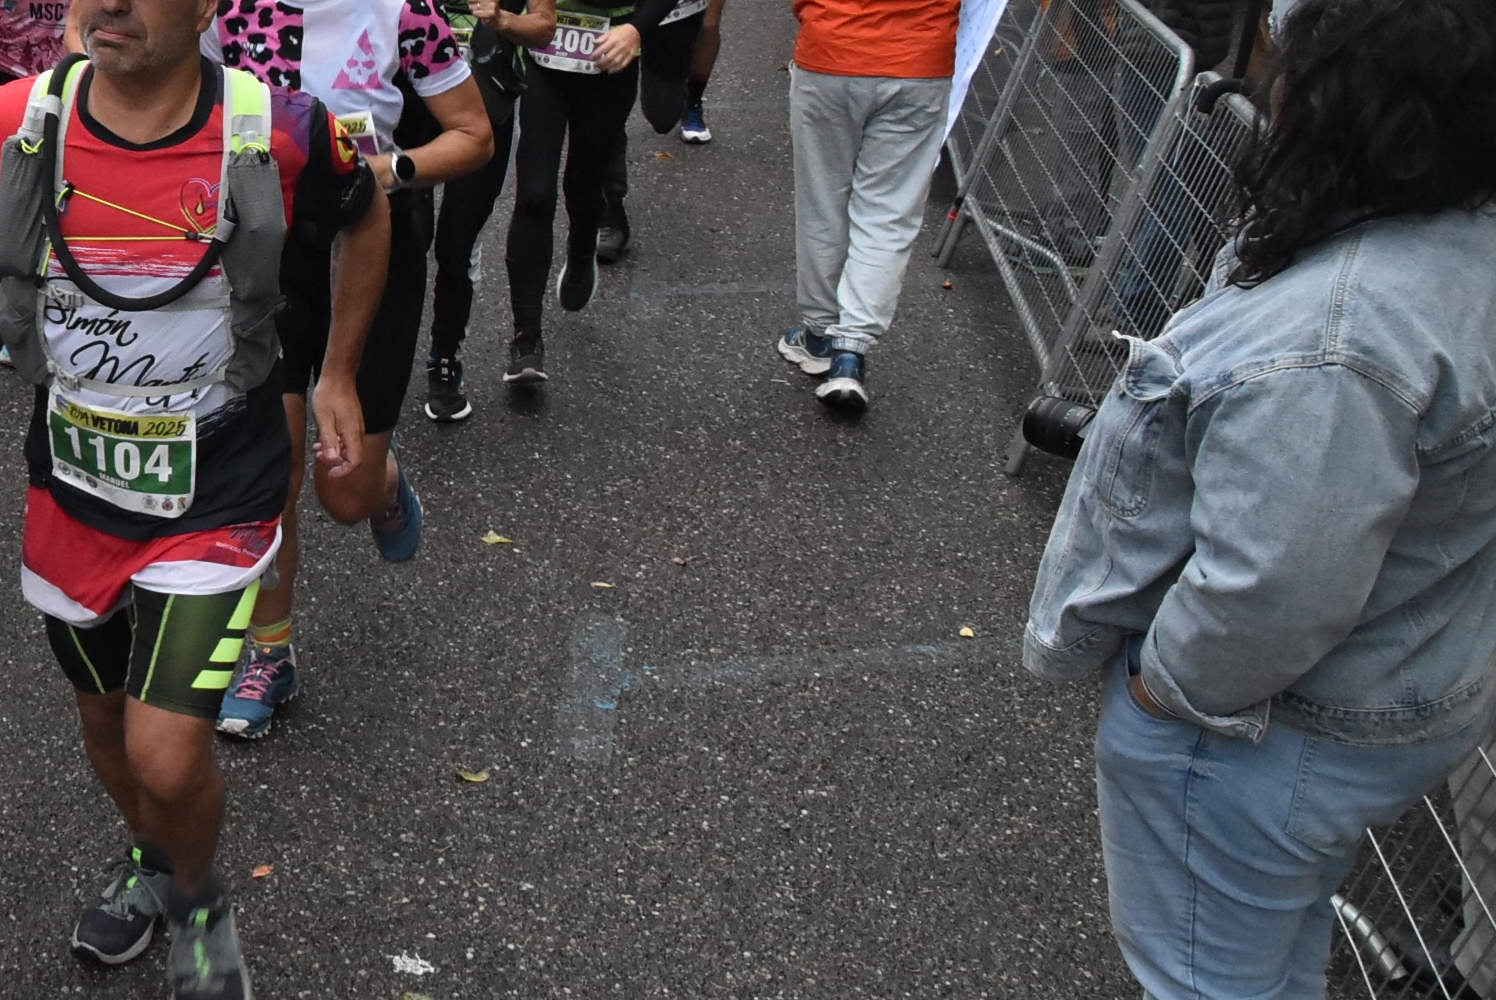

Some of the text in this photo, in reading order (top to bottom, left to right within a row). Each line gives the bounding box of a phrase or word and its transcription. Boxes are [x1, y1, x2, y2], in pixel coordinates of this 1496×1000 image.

[29, 2, 65, 21] MSC
[91, 415, 140, 436] VETONA
[142, 420, 187, 437] 2025
[63, 425, 173, 484] 1104
[98, 472, 131, 489] MANUEL
